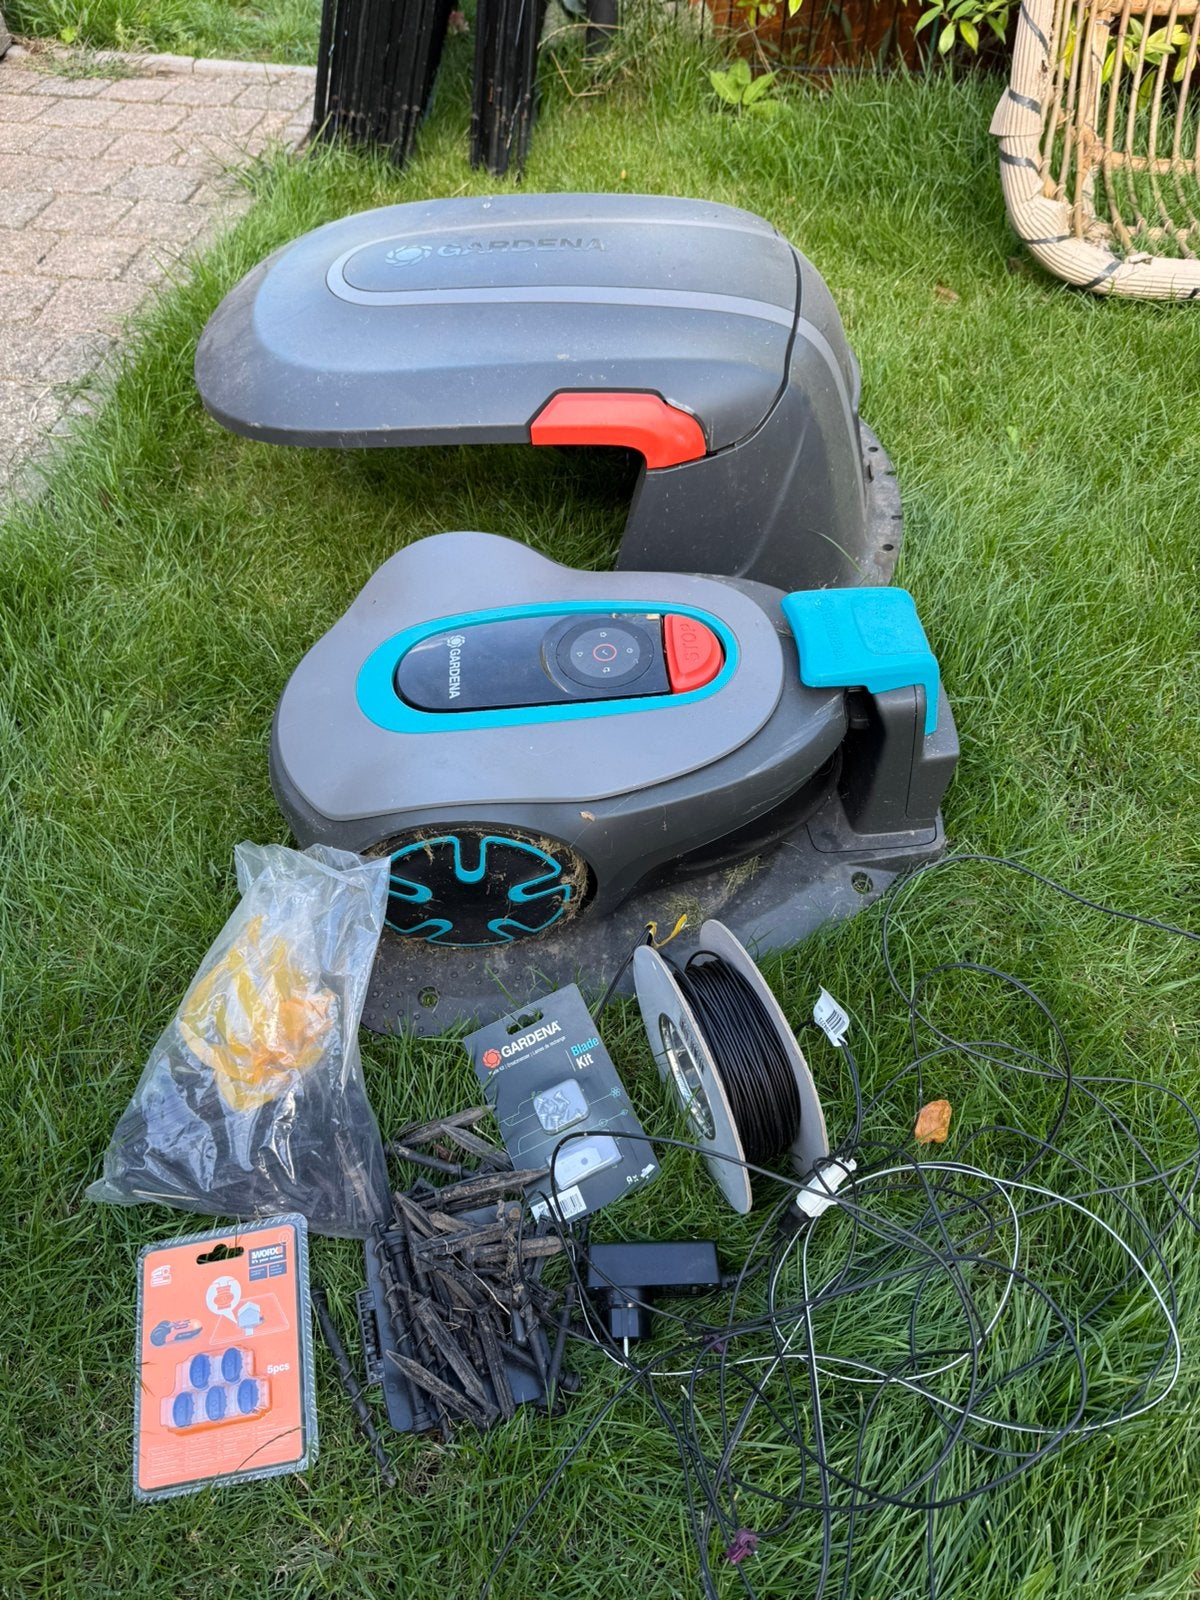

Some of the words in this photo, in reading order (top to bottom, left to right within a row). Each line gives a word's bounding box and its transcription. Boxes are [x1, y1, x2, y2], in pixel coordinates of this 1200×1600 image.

[437, 238, 606, 258] GARDENA
[680, 622, 700, 662] STOP
[449, 647, 461, 700] GARDENA
[501, 1020, 562, 1058] GARDENA
[571, 1036, 600, 1057] Blade
[575, 1053, 594, 1070] Kit
[267, 1362, 290, 1376] 5pcs
